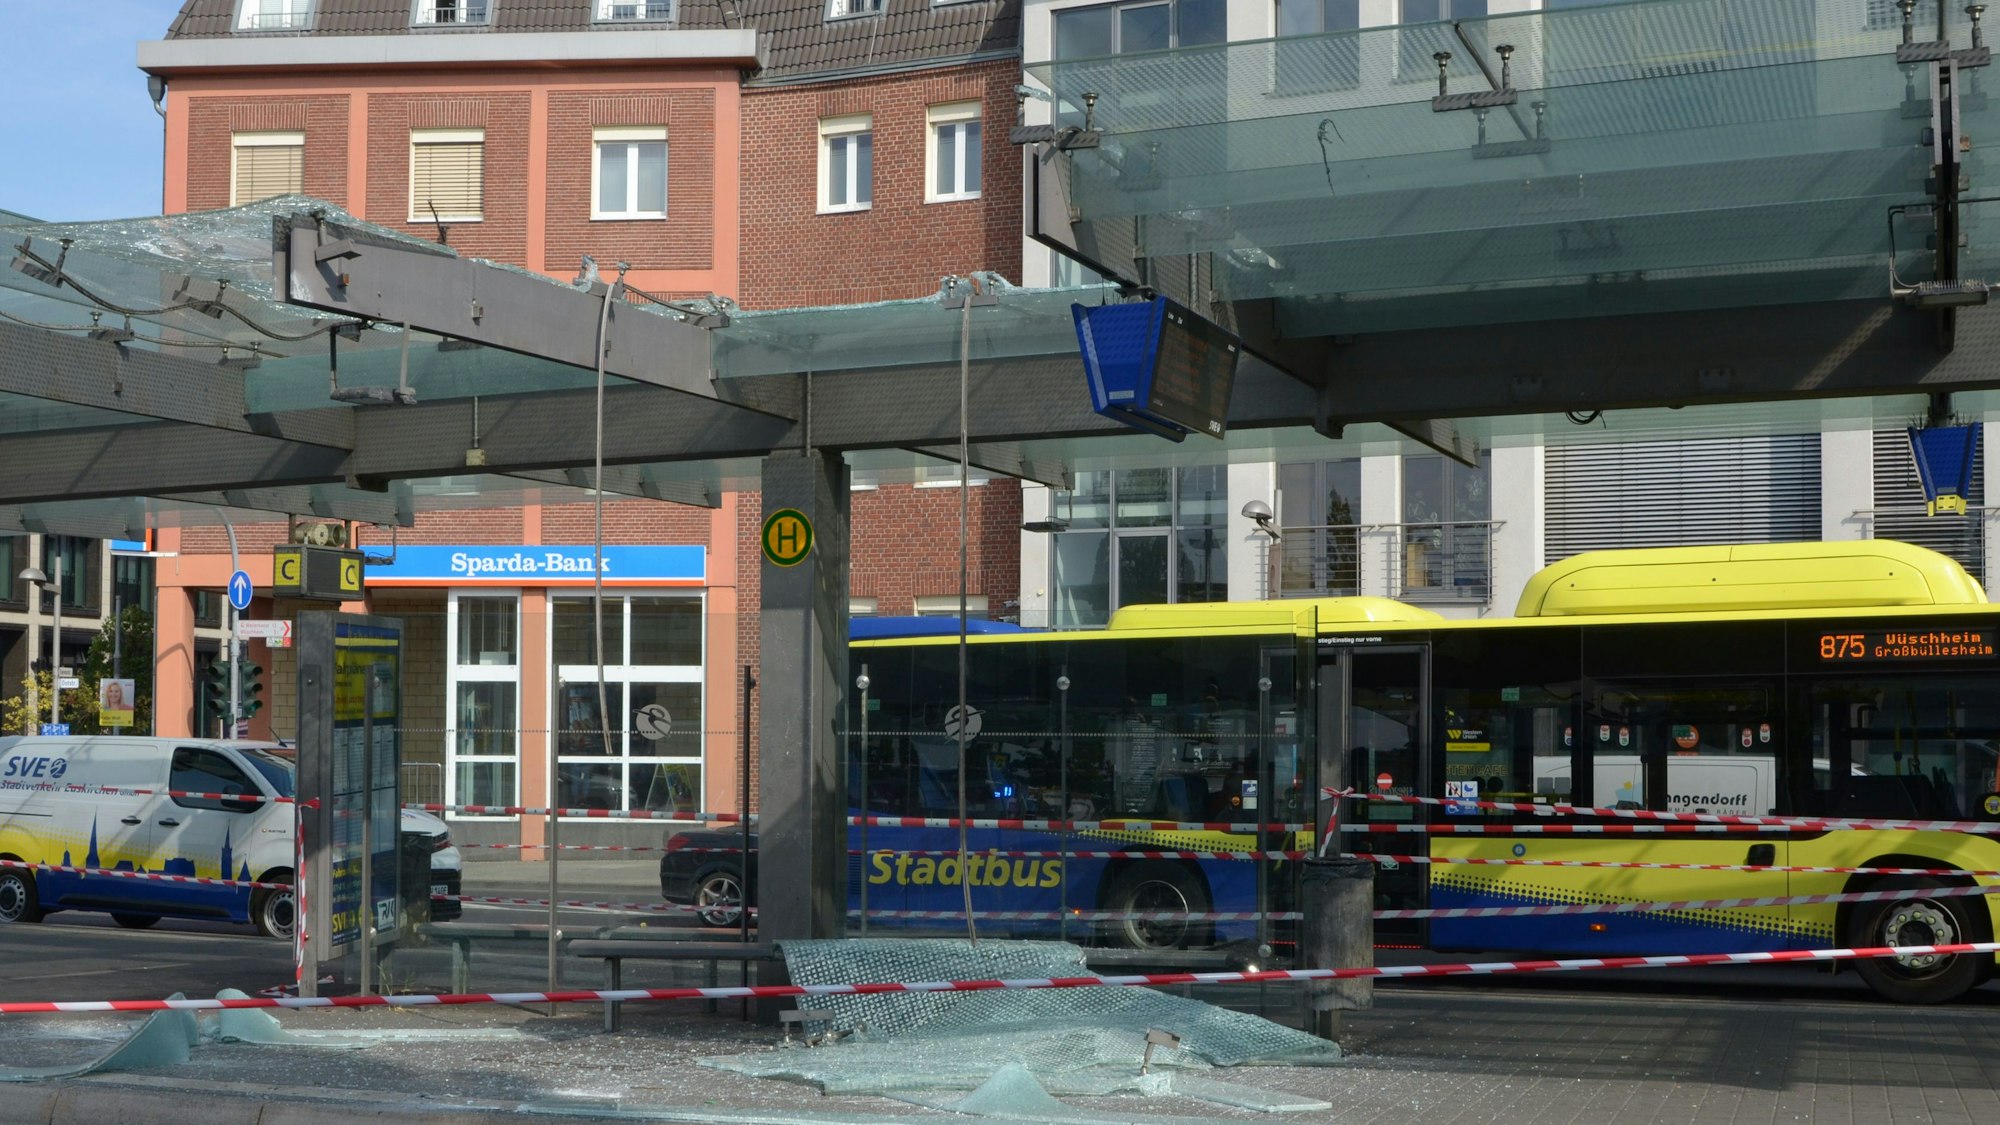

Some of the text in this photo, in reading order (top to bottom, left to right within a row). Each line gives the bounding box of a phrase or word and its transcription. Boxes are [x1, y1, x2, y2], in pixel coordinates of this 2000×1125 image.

[777, 521, 798, 553] H
[281, 559, 295, 580] C
[345, 564, 356, 586] C
[451, 552, 610, 576] Sparda-Bank
[1317, 637, 1355, 645] stieg/Einstieg
[1820, 634, 1866, 659] 875
[1885, 631, 1982, 645] Wüschheim
[1875, 643, 1993, 657] Großbüllesheim
[4, 755, 51, 778] SVE
[868, 849, 1062, 888] Stadtbus
